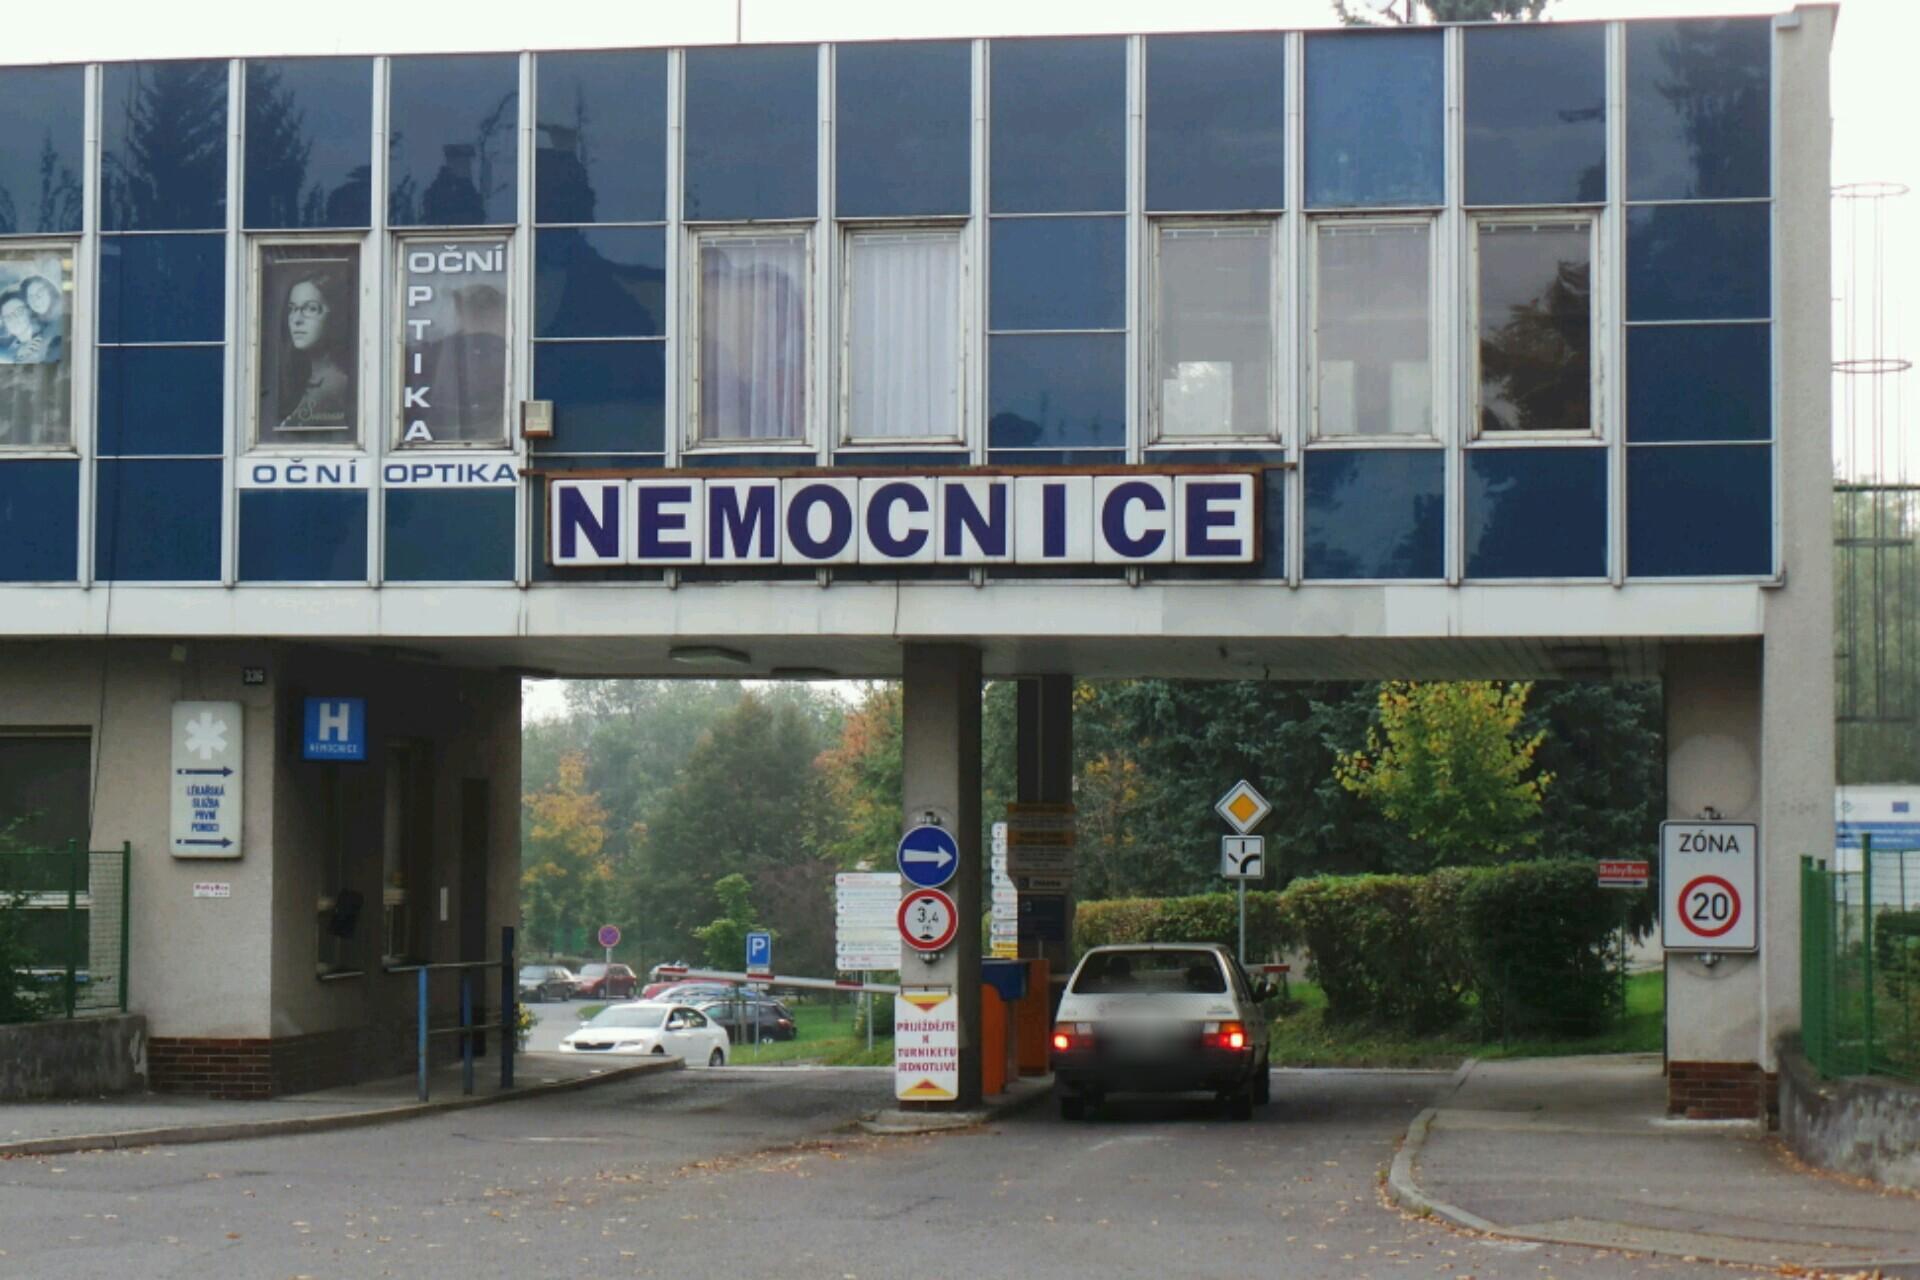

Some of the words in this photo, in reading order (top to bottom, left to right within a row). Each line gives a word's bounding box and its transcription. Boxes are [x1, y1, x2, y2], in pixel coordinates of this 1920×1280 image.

[408, 244, 504, 273] OČNÍ
[404, 285, 433, 441] OPTIKA
[252, 458, 357, 484] OČNÍ
[384, 464, 517, 483] OPTIKA
[558, 481, 1243, 559] NEMOCNICE
[318, 703, 349, 741] H
[1679, 831, 1740, 853] ZÓNA
[917, 906, 939, 923] 3,4
[1692, 892, 1728, 920] 20
[752, 938, 765, 956] P
